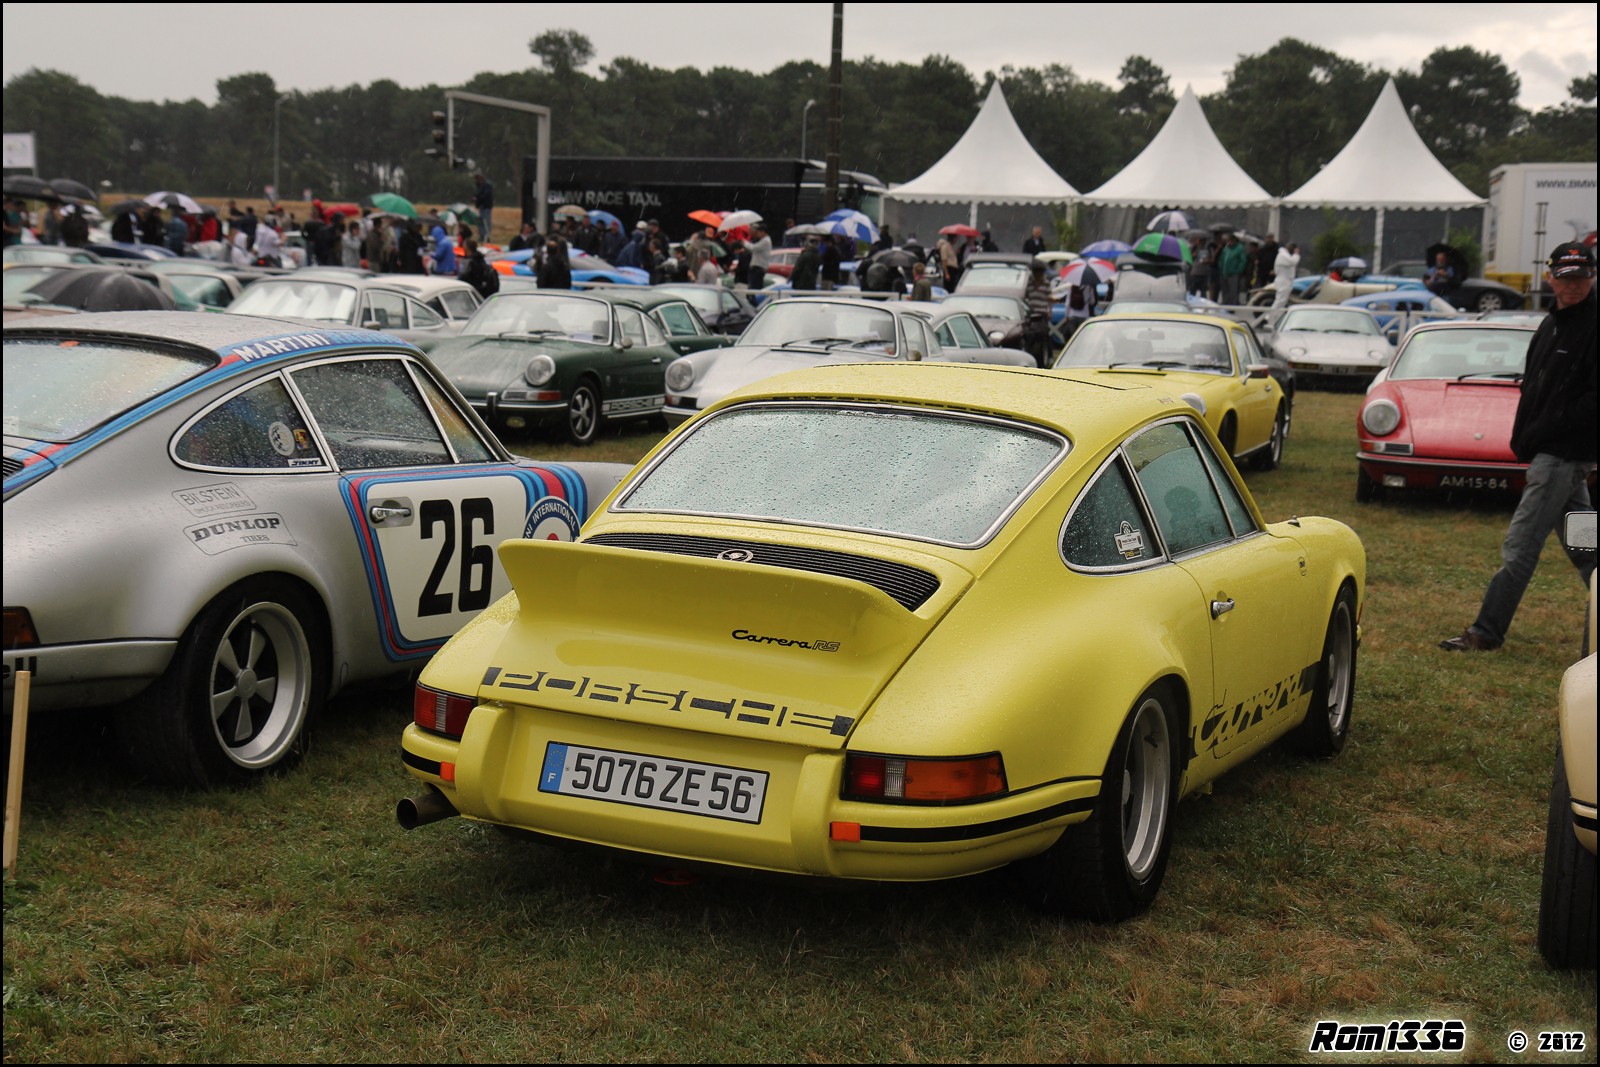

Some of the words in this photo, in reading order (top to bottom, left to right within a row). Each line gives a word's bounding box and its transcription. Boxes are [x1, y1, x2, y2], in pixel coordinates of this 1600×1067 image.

[547, 190, 582, 205] BMW
[585, 190, 624, 206] RACE
[232, 333, 331, 363] MARTINI
[1440, 475, 1508, 490] AM-15-84
[179, 486, 240, 506] BILSTEIN
[191, 517, 280, 542] DUNLOP
[240, 534, 270, 543] TIRES
[417, 497, 495, 618] 26
[731, 629, 812, 649] Carrera
[811, 639, 841, 653] RS
[494, 670, 840, 736] PORSCHE
[1194, 672, 1305, 756] Carrera
[547, 772, 557, 784] F
[571, 752, 658, 799] 5076
[659, 764, 706, 807] ZE
[708, 771, 755, 814] 56
